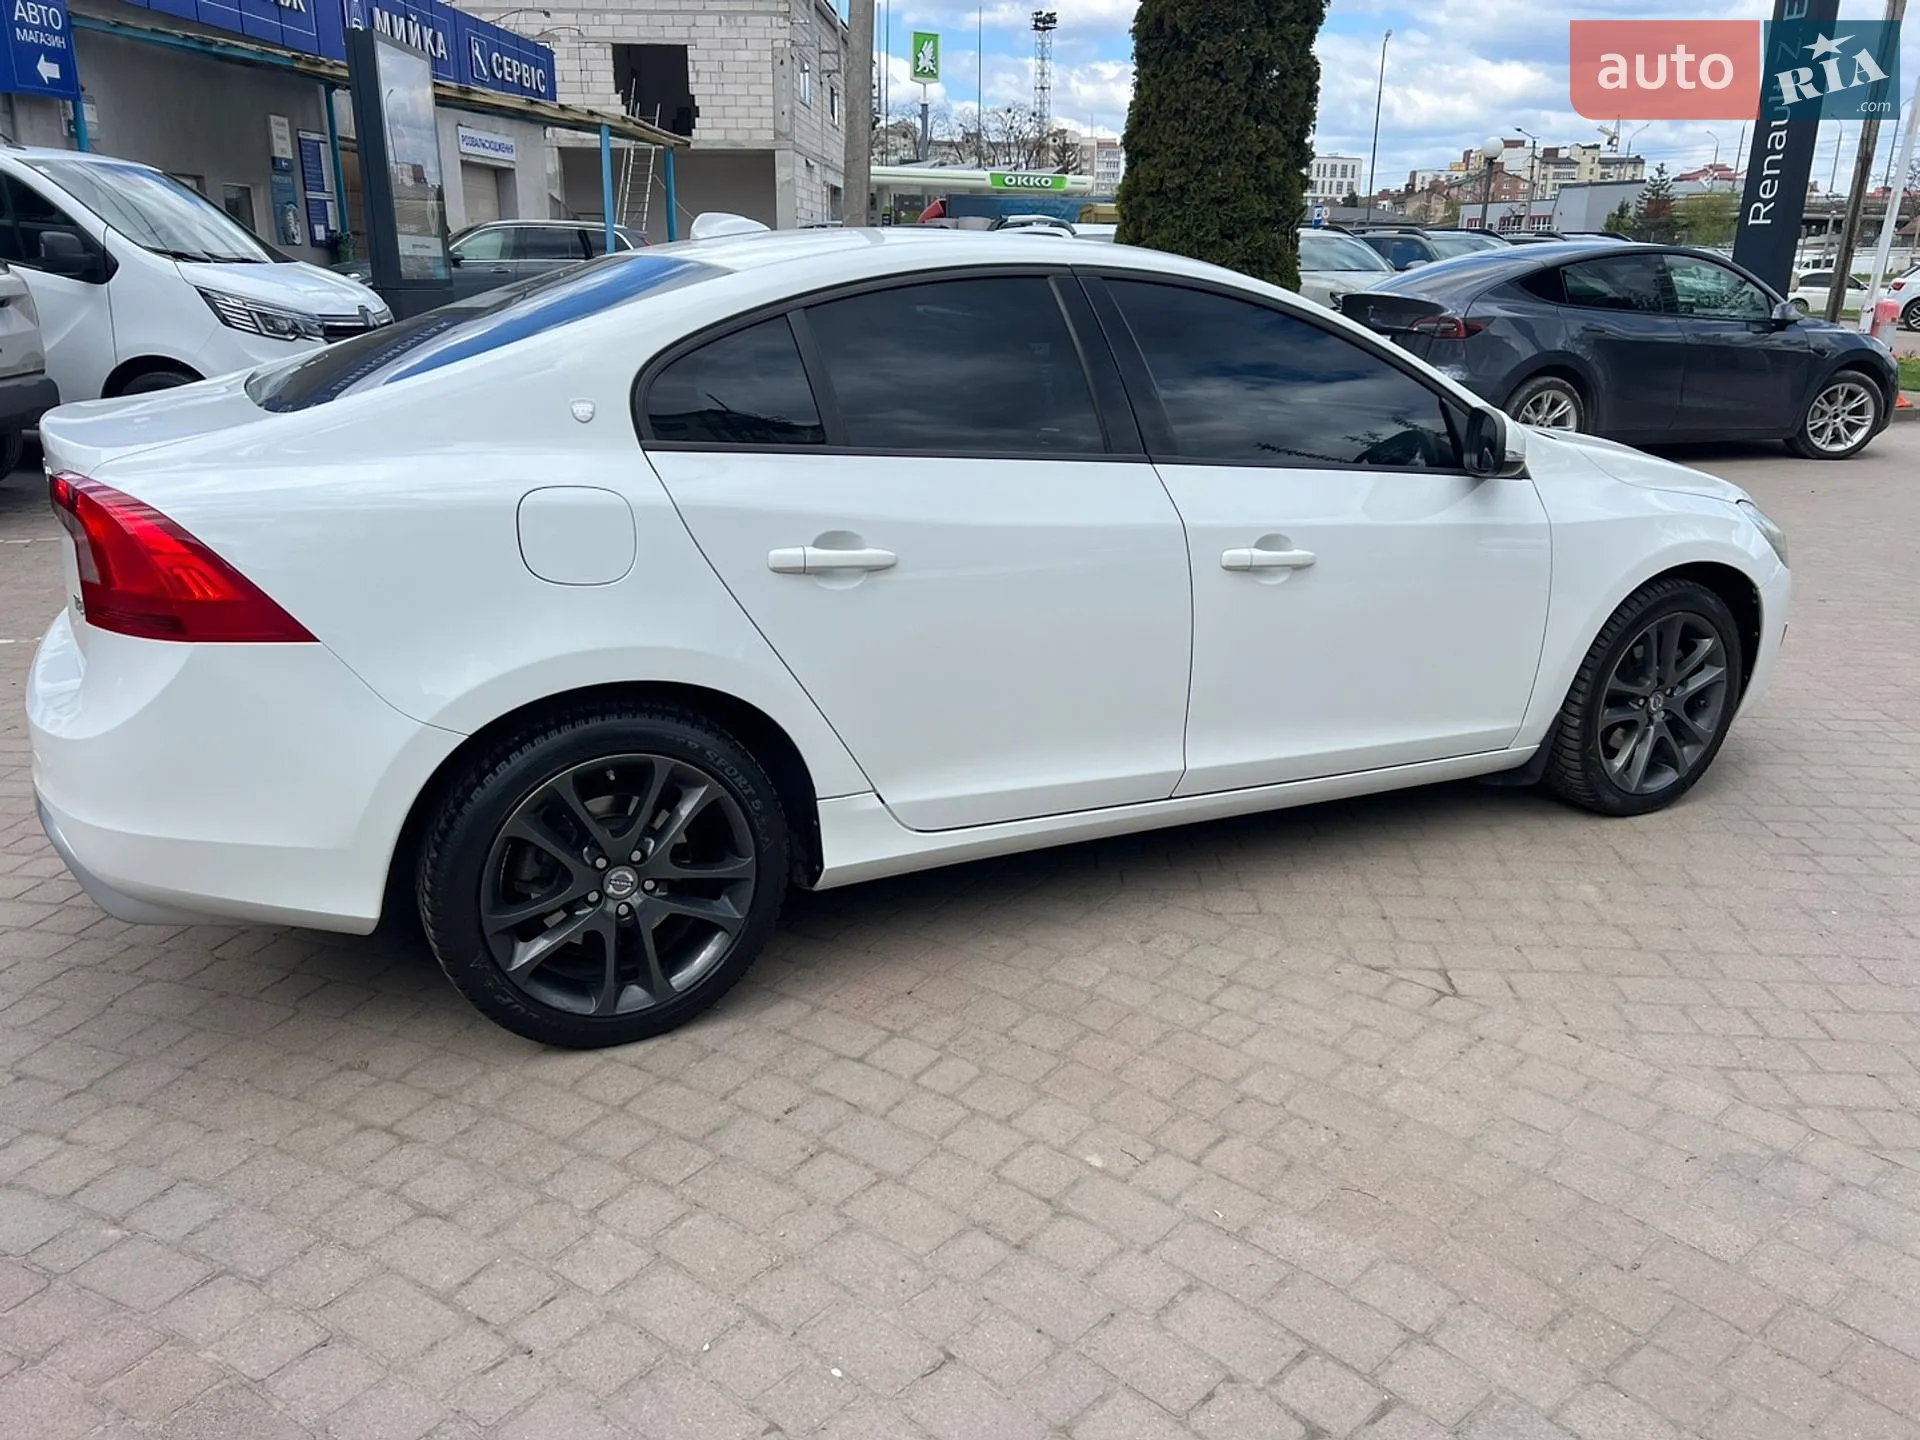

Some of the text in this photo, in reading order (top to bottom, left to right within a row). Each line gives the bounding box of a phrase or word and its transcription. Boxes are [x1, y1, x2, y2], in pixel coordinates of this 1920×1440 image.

[14, 0, 63, 31] АВТО
[16, 28, 66, 49] МАГАЗИН
[372, 7, 448, 61] МИЙКА
[491, 52, 546, 94] СЕРВІС
[1004, 175, 1052, 187] OKKO
